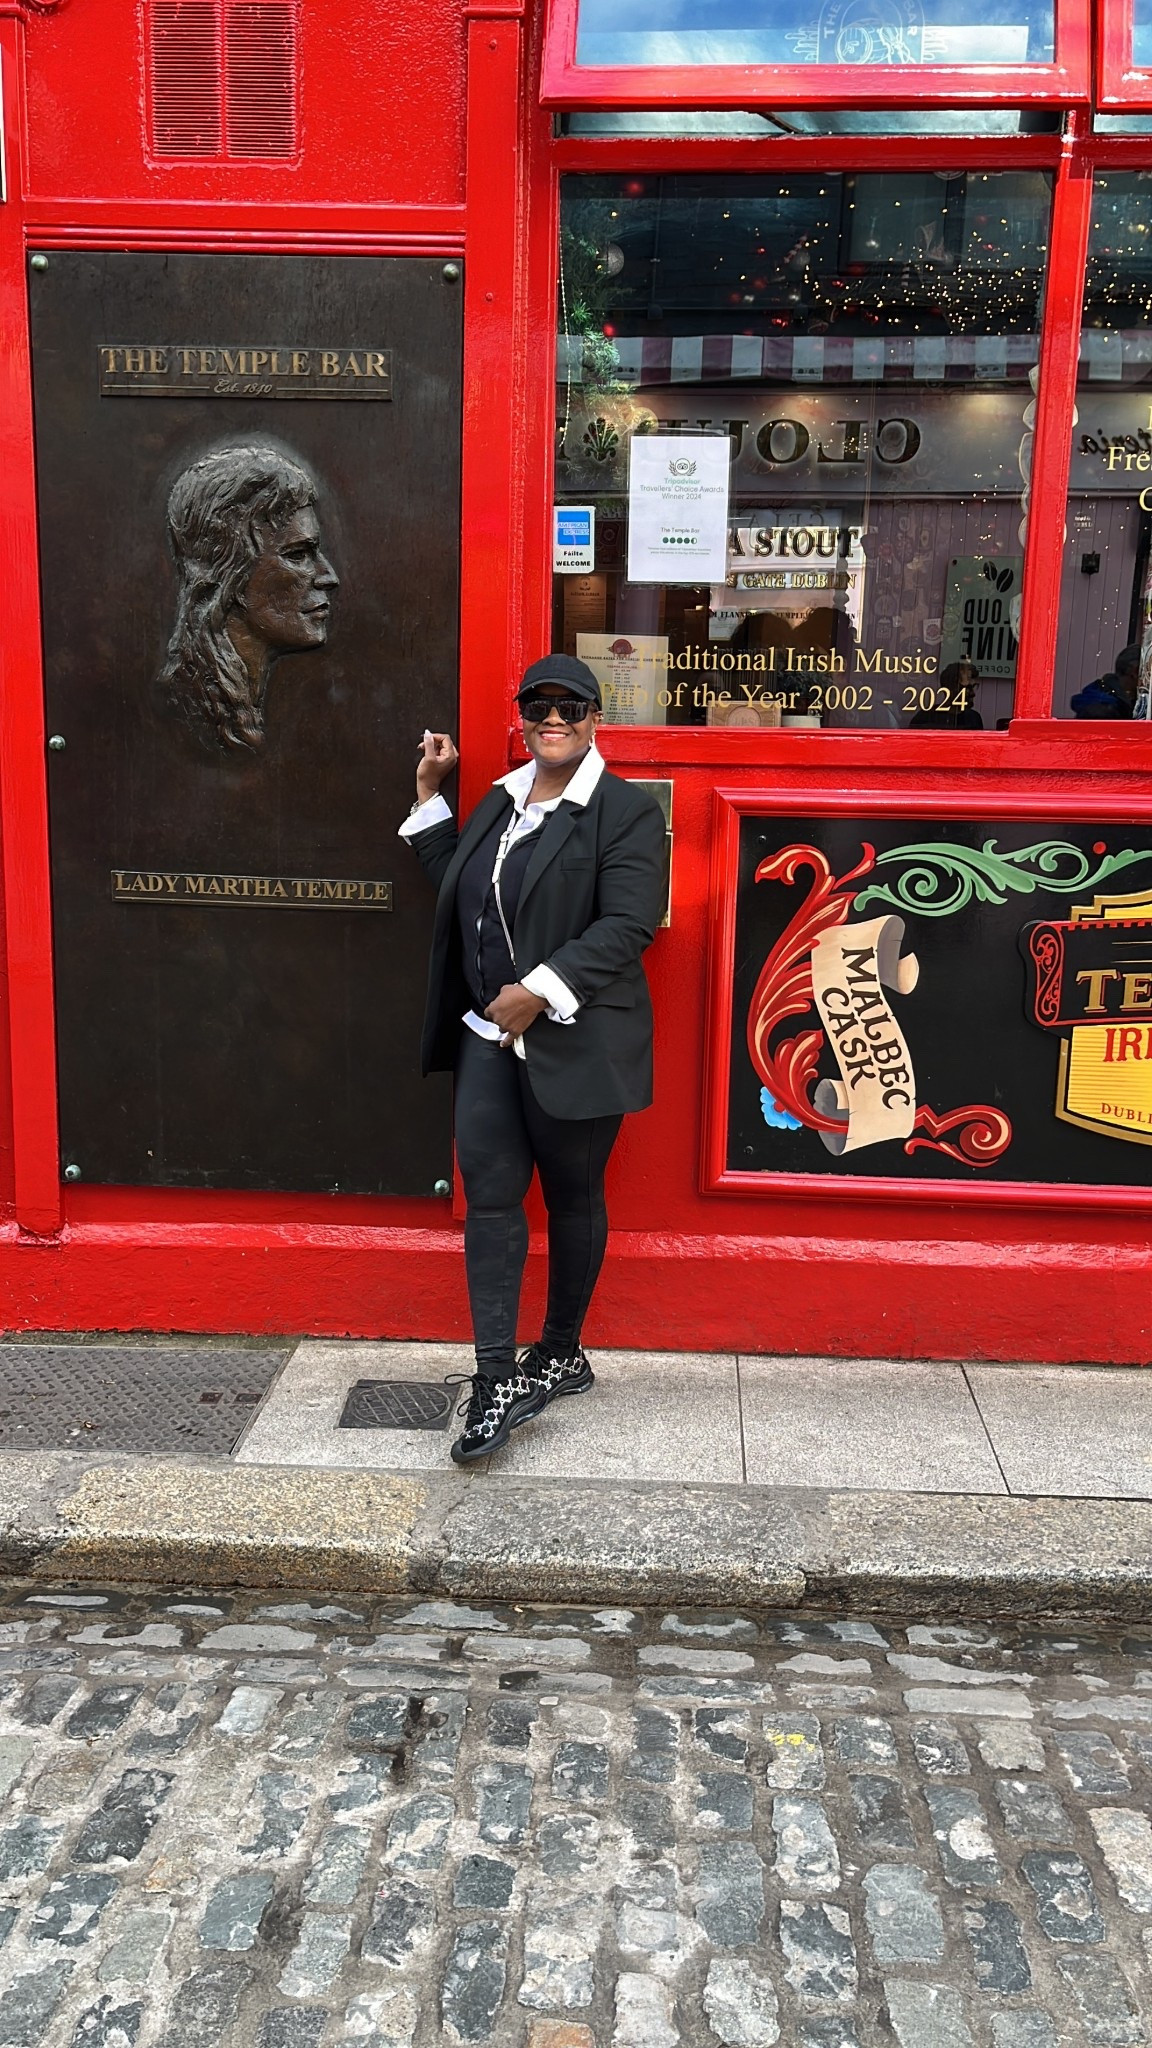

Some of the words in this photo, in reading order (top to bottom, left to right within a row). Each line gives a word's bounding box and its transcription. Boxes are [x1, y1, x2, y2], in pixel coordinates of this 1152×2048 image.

[101, 349, 169, 374] THE
[176, 350, 311, 376] TEMPLE
[319, 351, 389, 378] BAR
[213, 379, 239, 393] Est.
[243, 382, 273, 396] 1840
[1106, 446, 1152, 471] Fre
[675, 485, 698, 493] Choice
[672, 527, 690, 535] Temple
[754, 527, 859, 558] STOUT
[742, 573, 785, 589] GATE
[639, 643, 776, 672] Traditional
[784, 646, 846, 674] Irish
[853, 647, 938, 675] Music
[657, 682, 689, 708] of
[693, 684, 733, 709] the
[739, 684, 801, 711] Year
[808, 685, 874, 711] 2002
[901, 686, 969, 712] 2024
[115, 873, 179, 893] LADY
[184, 877, 289, 898] MARTHA
[291, 880, 389, 900] TEMPLE
[821, 987, 877, 1091] CASK
[841, 946, 911, 1110] MALBEC
